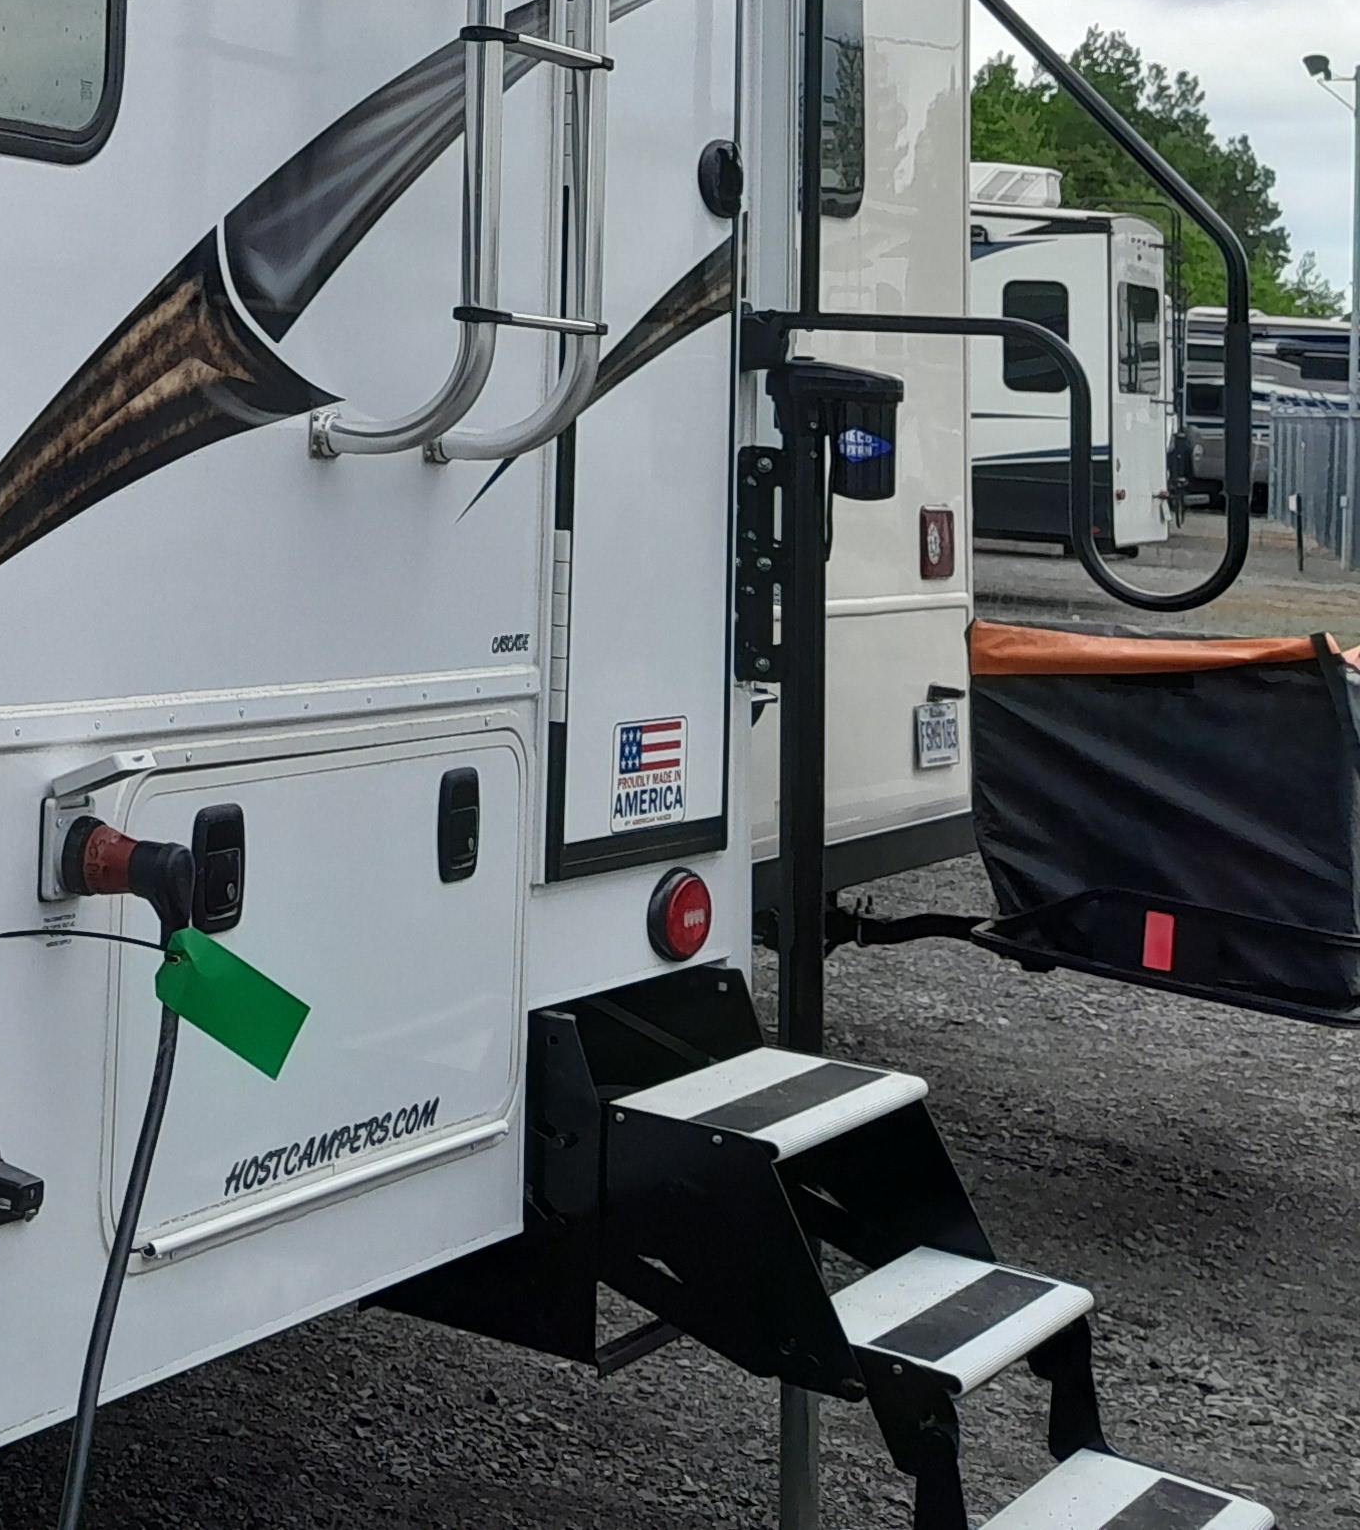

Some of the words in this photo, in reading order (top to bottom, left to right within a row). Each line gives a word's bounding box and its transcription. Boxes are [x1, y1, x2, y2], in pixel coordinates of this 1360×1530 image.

[617, 773, 651, 790] PROUDLY
[652, 770, 673, 785] MADE
[673, 769, 682, 783] IN
[612, 784, 683, 820] AMERICA
[223, 1095, 441, 1198] HOSTCAMPERS.COM
